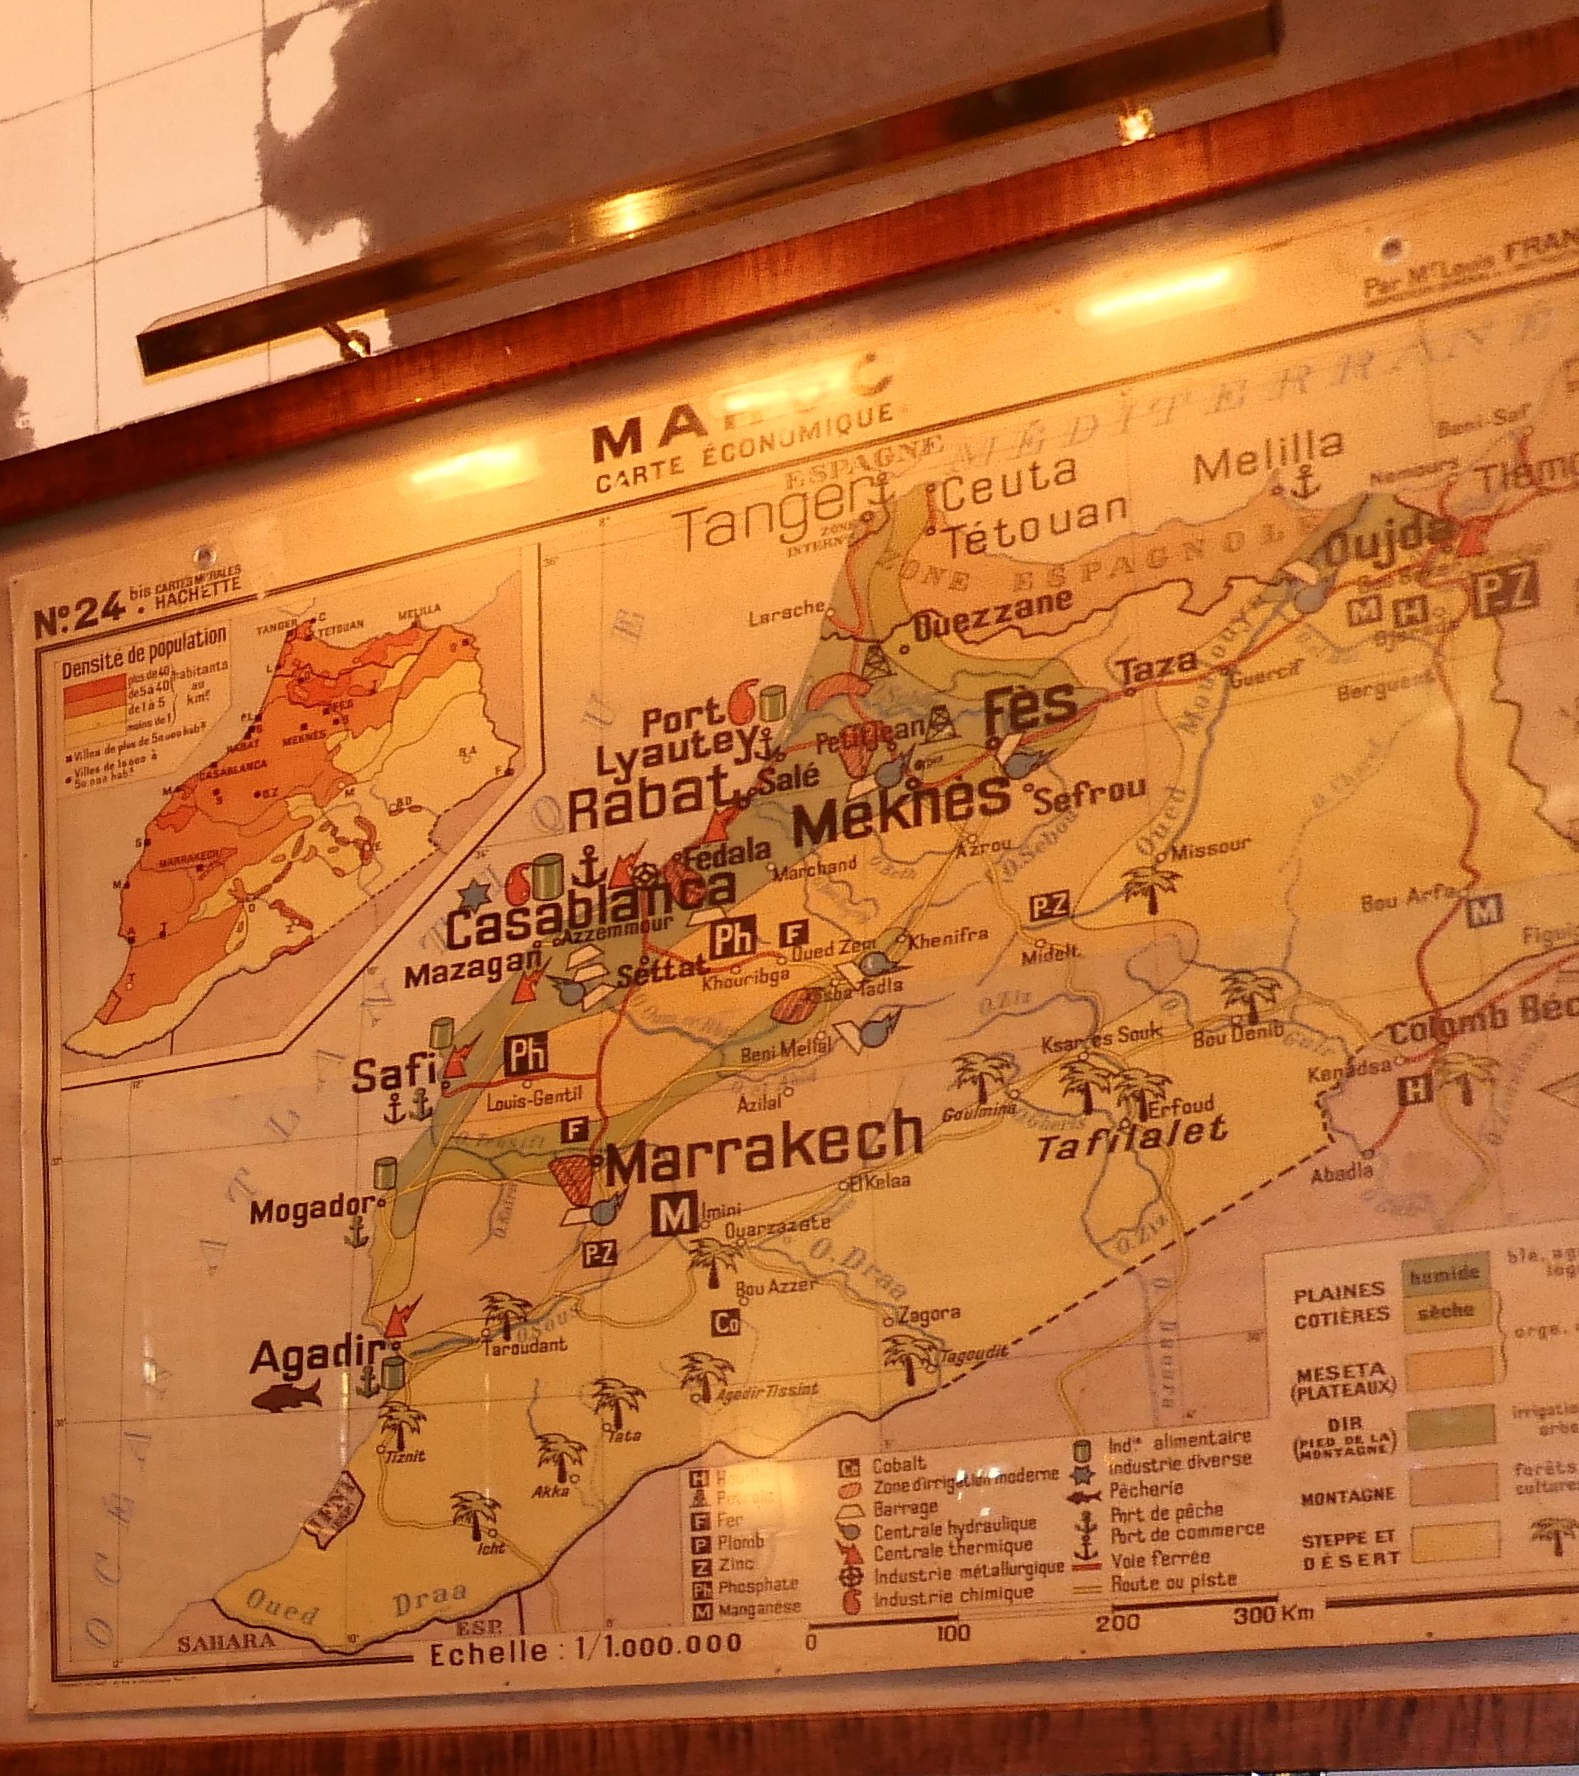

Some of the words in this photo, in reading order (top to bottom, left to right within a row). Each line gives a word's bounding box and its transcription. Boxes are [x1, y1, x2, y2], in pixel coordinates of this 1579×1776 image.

[596, 455, 685, 494] CARTE
[703, 403, 894, 467] ÉCONOMIQUE
[1193, 428, 1344, 485] Melilla
[944, 457, 1078, 511] Ceuta
[672, 474, 876, 552] Tanger
[942, 496, 1128, 559] Tétouan
[129, 583, 151, 600] bis
[155, 578, 193, 594] CARTES
[155, 577, 241, 609] HACHETTE
[914, 589, 1074, 642] Ouezzane
[128, 645, 144, 664] de
[150, 626, 227, 663] population
[1115, 651, 1199, 686] Taza
[643, 697, 726, 738] Port
[986, 684, 1078, 748] Fès
[597, 725, 761, 785] Lyautey
[757, 761, 820, 796] Salé
[569, 764, 732, 832] Rabat
[1034, 779, 1146, 816] Sefrou
[955, 839, 1011, 860] Azrou
[1172, 837, 1252, 862] Missour
[773, 855, 857, 882] Marchand
[447, 871, 736, 950] Casablanca
[1468, 895, 1504, 928] M
[564, 914, 673, 945] Azzemmour
[712, 922, 754, 957] Ph
[784, 923, 806, 946] F
[909, 927, 989, 950] Khenifra
[405, 950, 541, 989] Mazagan
[618, 954, 711, 988] Settat
[702, 968, 790, 993] Khouribga
[1119, 1020, 1163, 1042] Souk
[1391, 1006, 1508, 1045] Colomb
[1194, 1030, 1226, 1048] Bou
[508, 1037, 547, 1075] Ph
[741, 1045, 776, 1061] Beni
[352, 1052, 437, 1094] Safi
[487, 1085, 583, 1112] Louis-Gentil
[1401, 1075, 1430, 1104] H
[1148, 1094, 1215, 1120] Erfoud
[564, 1117, 586, 1143] F
[1038, 1112, 1228, 1163] Tafilalet
[606, 1108, 923, 1186] Marrakech
[865, 1172, 911, 1191] Kelaa
[250, 1193, 376, 1229] Mogador
[656, 1196, 695, 1236] M
[701, 1202, 742, 1220] Imini
[725, 1215, 831, 1239] Ouarzazate
[583, 1242, 616, 1267] P-Z
[1410, 1263, 1481, 1286] humide
[736, 1281, 765, 1297] Bou
[769, 1277, 817, 1295] Azzer
[1294, 1281, 1386, 1305] PLAINES
[712, 1311, 741, 1335] Co
[897, 1307, 961, 1325] Zagora
[250, 1332, 387, 1382] Agadir
[483, 1336, 568, 1357] Taroudant
[1297, 1361, 1387, 1383] MESETA
[1291, 1375, 1397, 1406] (PLATEAUX)
[1328, 1416, 1363, 1433] DIR
[1154, 1430, 1252, 1451] alimentaire
[1345, 1435, 1364, 1445] DE
[385, 1450, 426, 1464] Tiznit
[873, 1456, 927, 1474] Cobalt
[1187, 1452, 1253, 1470] diverse
[531, 1486, 570, 1499] Akka
[874, 1480, 910, 1495] Zone
[1301, 1486, 1396, 1507] MONTAGNE
[692, 1513, 706, 1531] F
[718, 1513, 743, 1527] Fer
[874, 1500, 939, 1520] Barrage
[1151, 1503, 1170, 1521] de
[1176, 1501, 1224, 1523] pêche
[874, 1523, 943, 1542] Centrale
[948, 1516, 1038, 1541] hydraulique
[1151, 1524, 1170, 1542] de
[1176, 1522, 1265, 1540] commerce
[1302, 1529, 1368, 1548] STEPPE
[1376, 1529, 1396, 1543] ET
[477, 1542, 505, 1556] Icht
[693, 1535, 708, 1554] P
[718, 1532, 764, 1549] Plomb
[874, 1544, 944, 1562] Centrale
[949, 1539, 1033, 1558] thermique
[693, 1559, 711, 1578] Z
[719, 1558, 754, 1572] Zinc
[1112, 1552, 1145, 1569] Voie
[1152, 1549, 1211, 1566] ferrée
[1303, 1551, 1401, 1571] DÉSERT
[875, 1566, 952, 1585] Industrie
[960, 1560, 1065, 1581] métallurgique
[1112, 1575, 1160, 1593] Route
[1167, 1576, 1185, 1589] ou
[1191, 1571, 1238, 1593] piste
[719, 1577, 799, 1595] Phosphate
[875, 1591, 953, 1607] Industrie
[960, 1585, 1035, 1605] chimique
[246, 1588, 320, 1625] Oued
[393, 1584, 467, 1618] Draa
[693, 1603, 713, 1622] M
[1234, 1605, 1276, 1625] 300
[1282, 1604, 1315, 1622] Km
[938, 1624, 971, 1642] 100
[1096, 1613, 1141, 1633] 200
[178, 1633, 275, 1652] SAHARA
[431, 1641, 548, 1668] Echelle
[576, 1632, 742, 1660] 1/1.000.000
[806, 1634, 817, 1651] 0
